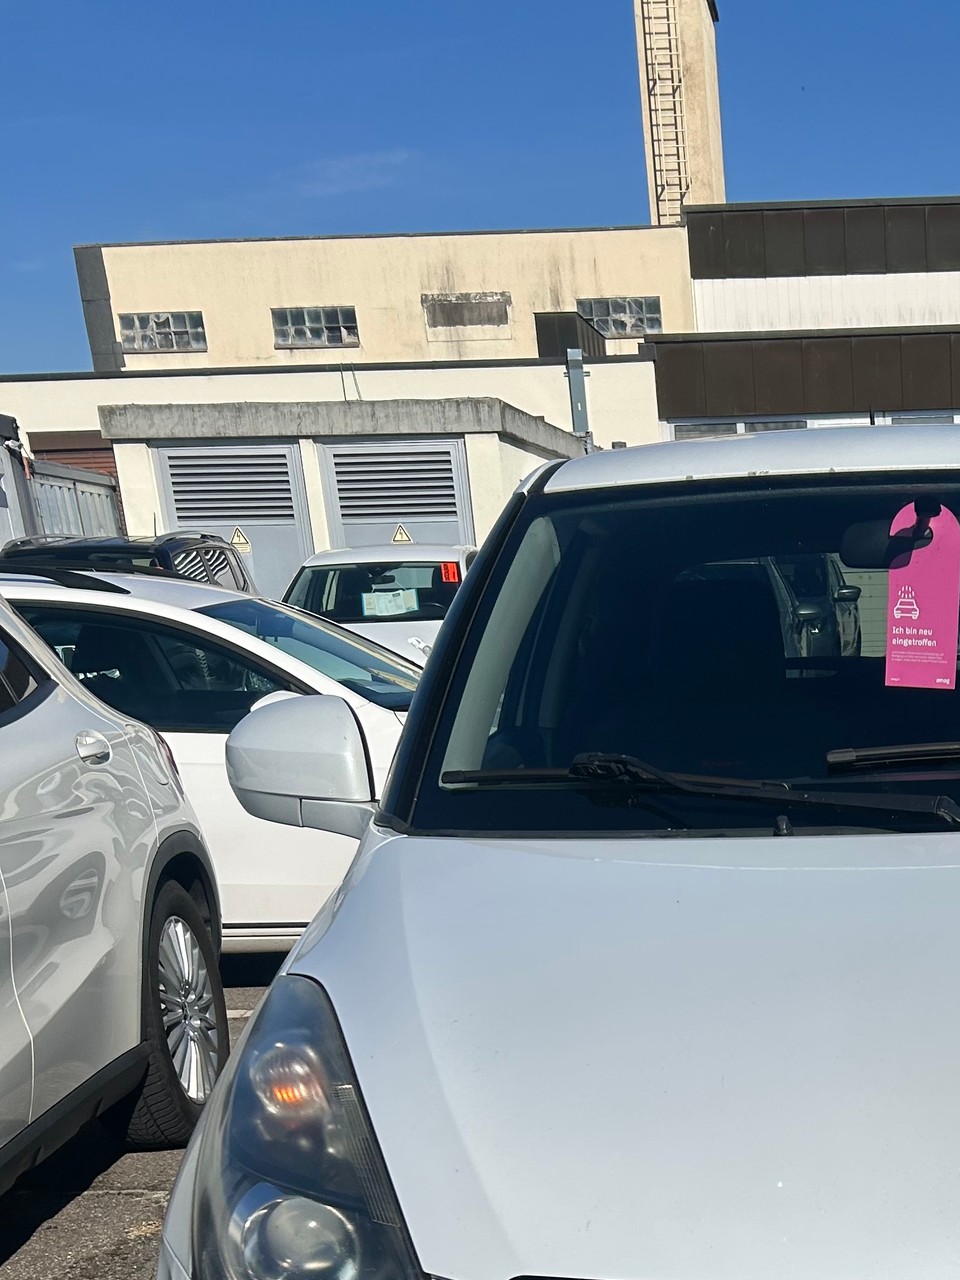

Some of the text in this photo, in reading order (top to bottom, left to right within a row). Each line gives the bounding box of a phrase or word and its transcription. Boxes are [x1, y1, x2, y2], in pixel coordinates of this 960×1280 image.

[892, 626, 933, 636] Ich bin neu
[892, 637, 937, 647] eingetroffen
